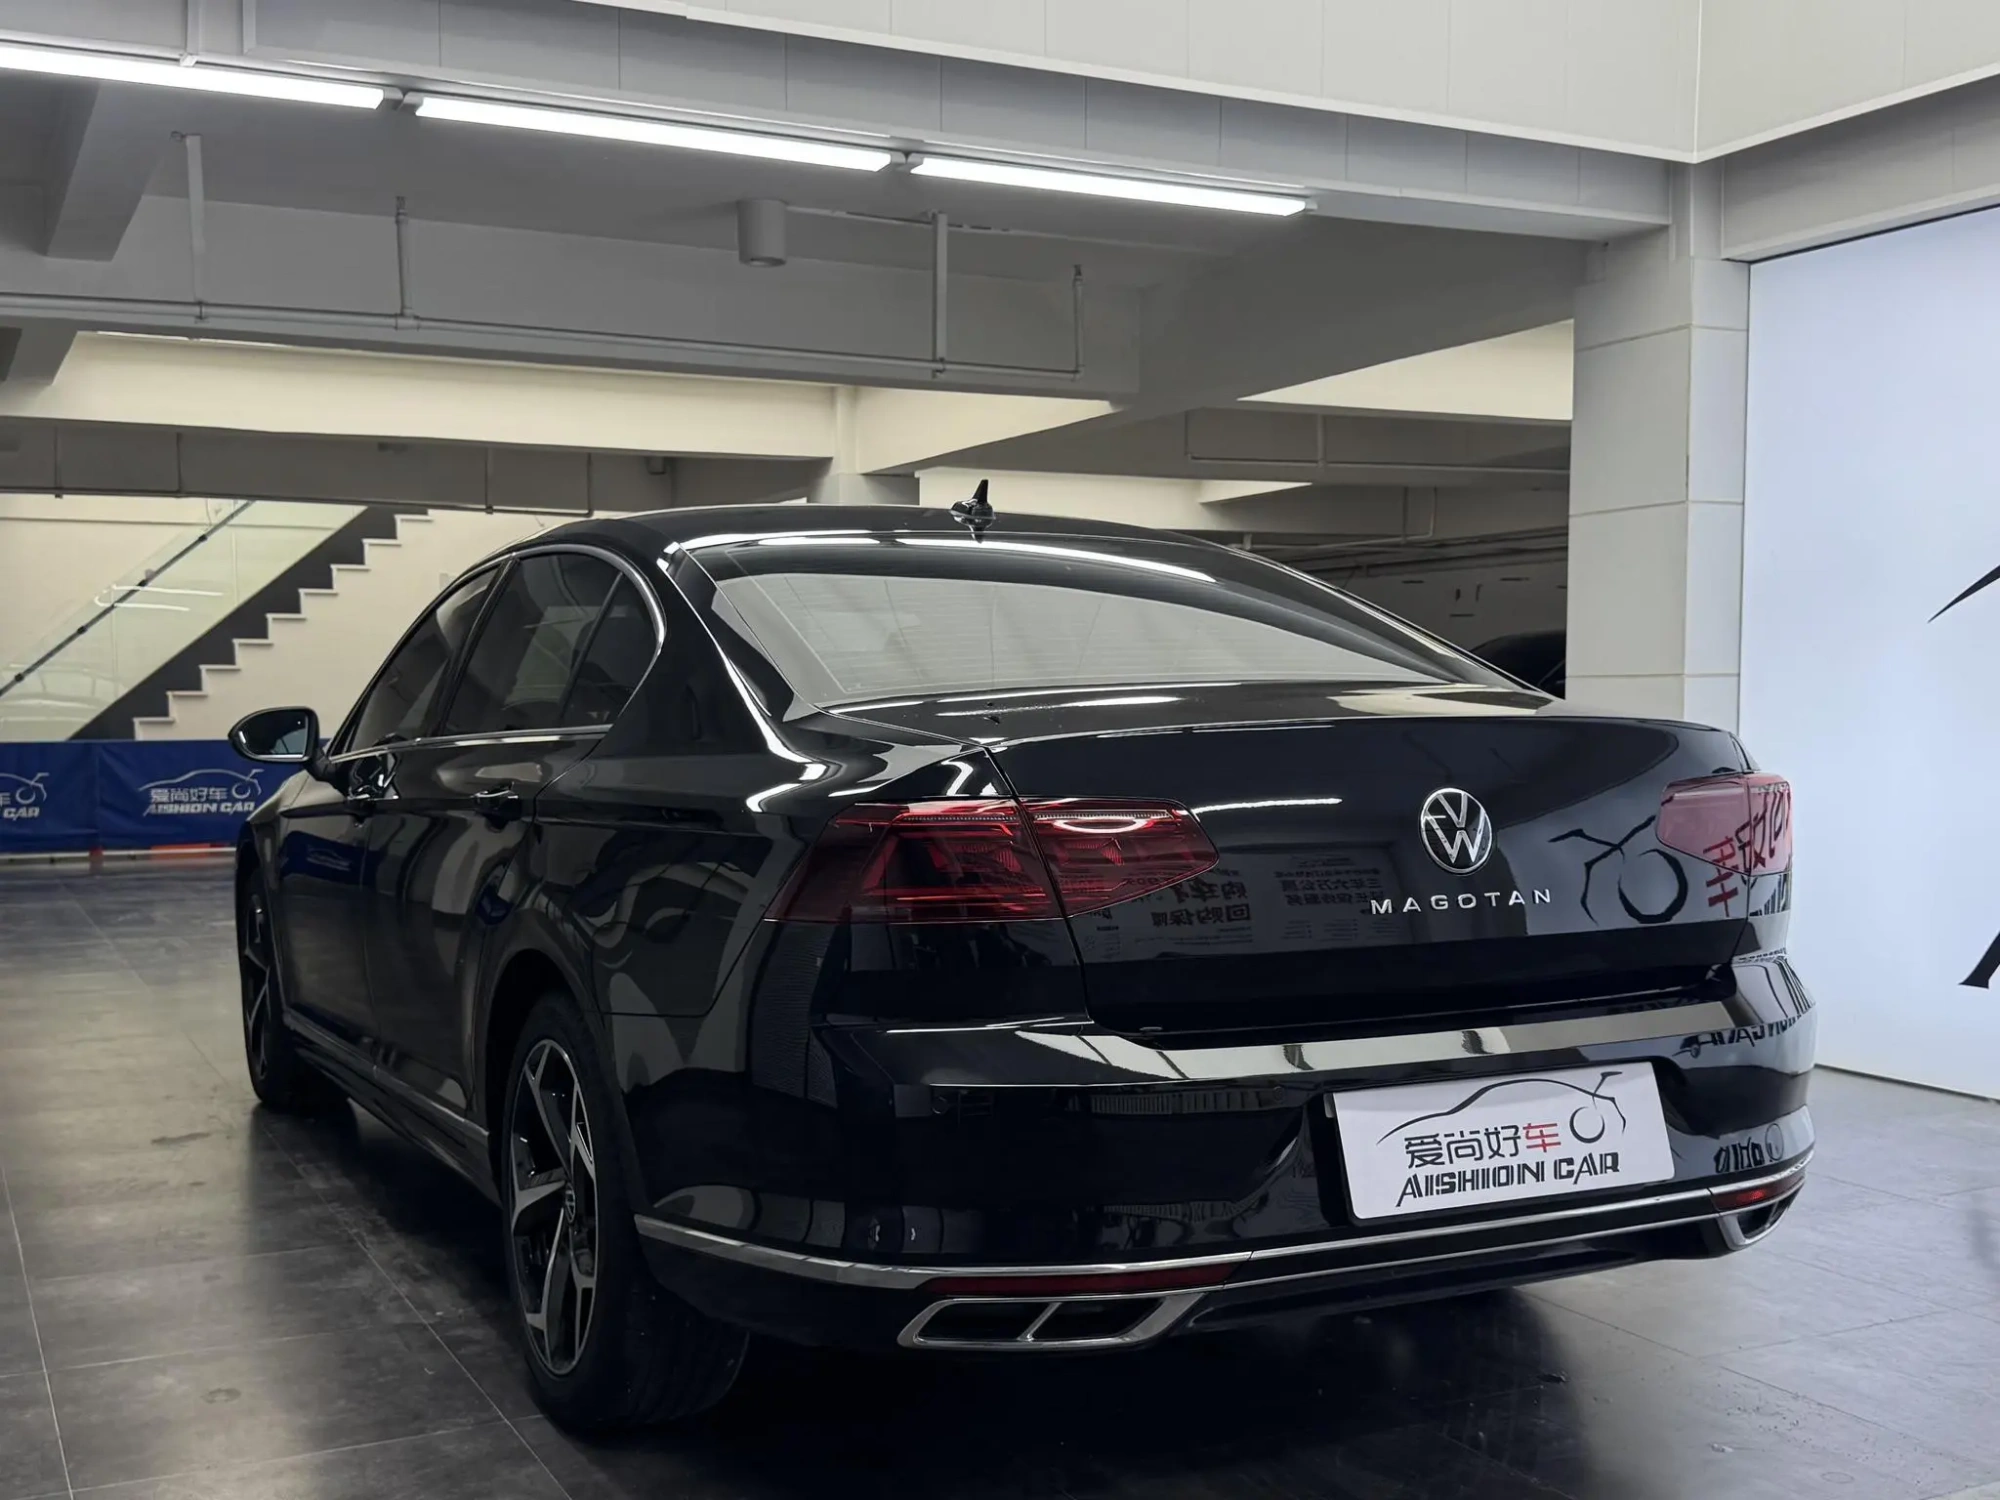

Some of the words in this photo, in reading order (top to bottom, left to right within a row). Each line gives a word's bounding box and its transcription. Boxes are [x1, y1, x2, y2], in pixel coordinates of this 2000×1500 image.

[151, 788, 227, 802] 爱尚好车
[3, 807, 40, 821] CAR
[220, 801, 255, 815] CAR
[1371, 889, 1550, 914] MAGOTAN
[1404, 1123, 1562, 1168] 爱尚好车
[1395, 1161, 1545, 1207] AISHION
[1553, 1152, 1620, 1184] CAR
